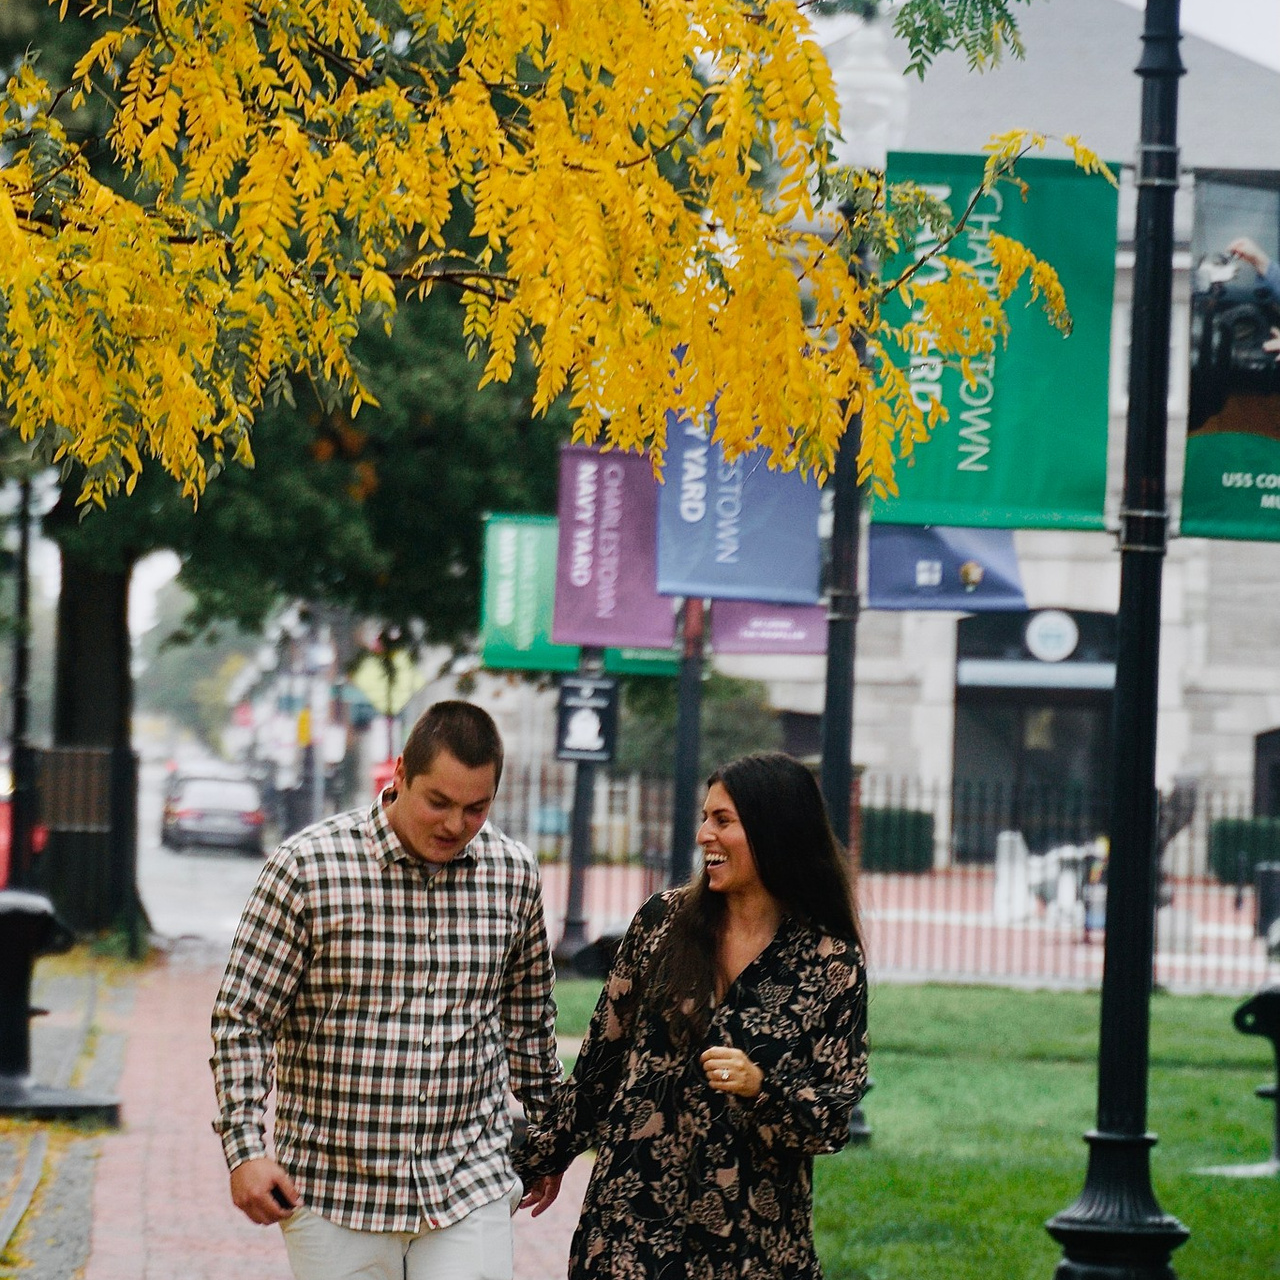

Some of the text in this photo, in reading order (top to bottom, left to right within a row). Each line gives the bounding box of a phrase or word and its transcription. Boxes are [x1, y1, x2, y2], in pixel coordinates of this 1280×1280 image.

[908, 309, 945, 413] ARD
[957, 186, 1003, 472] CHARTOWN
[571, 460, 599, 588] NAVY YARD
[680, 446, 708, 523] YARD
[1222, 472, 1280, 489] USS CO
